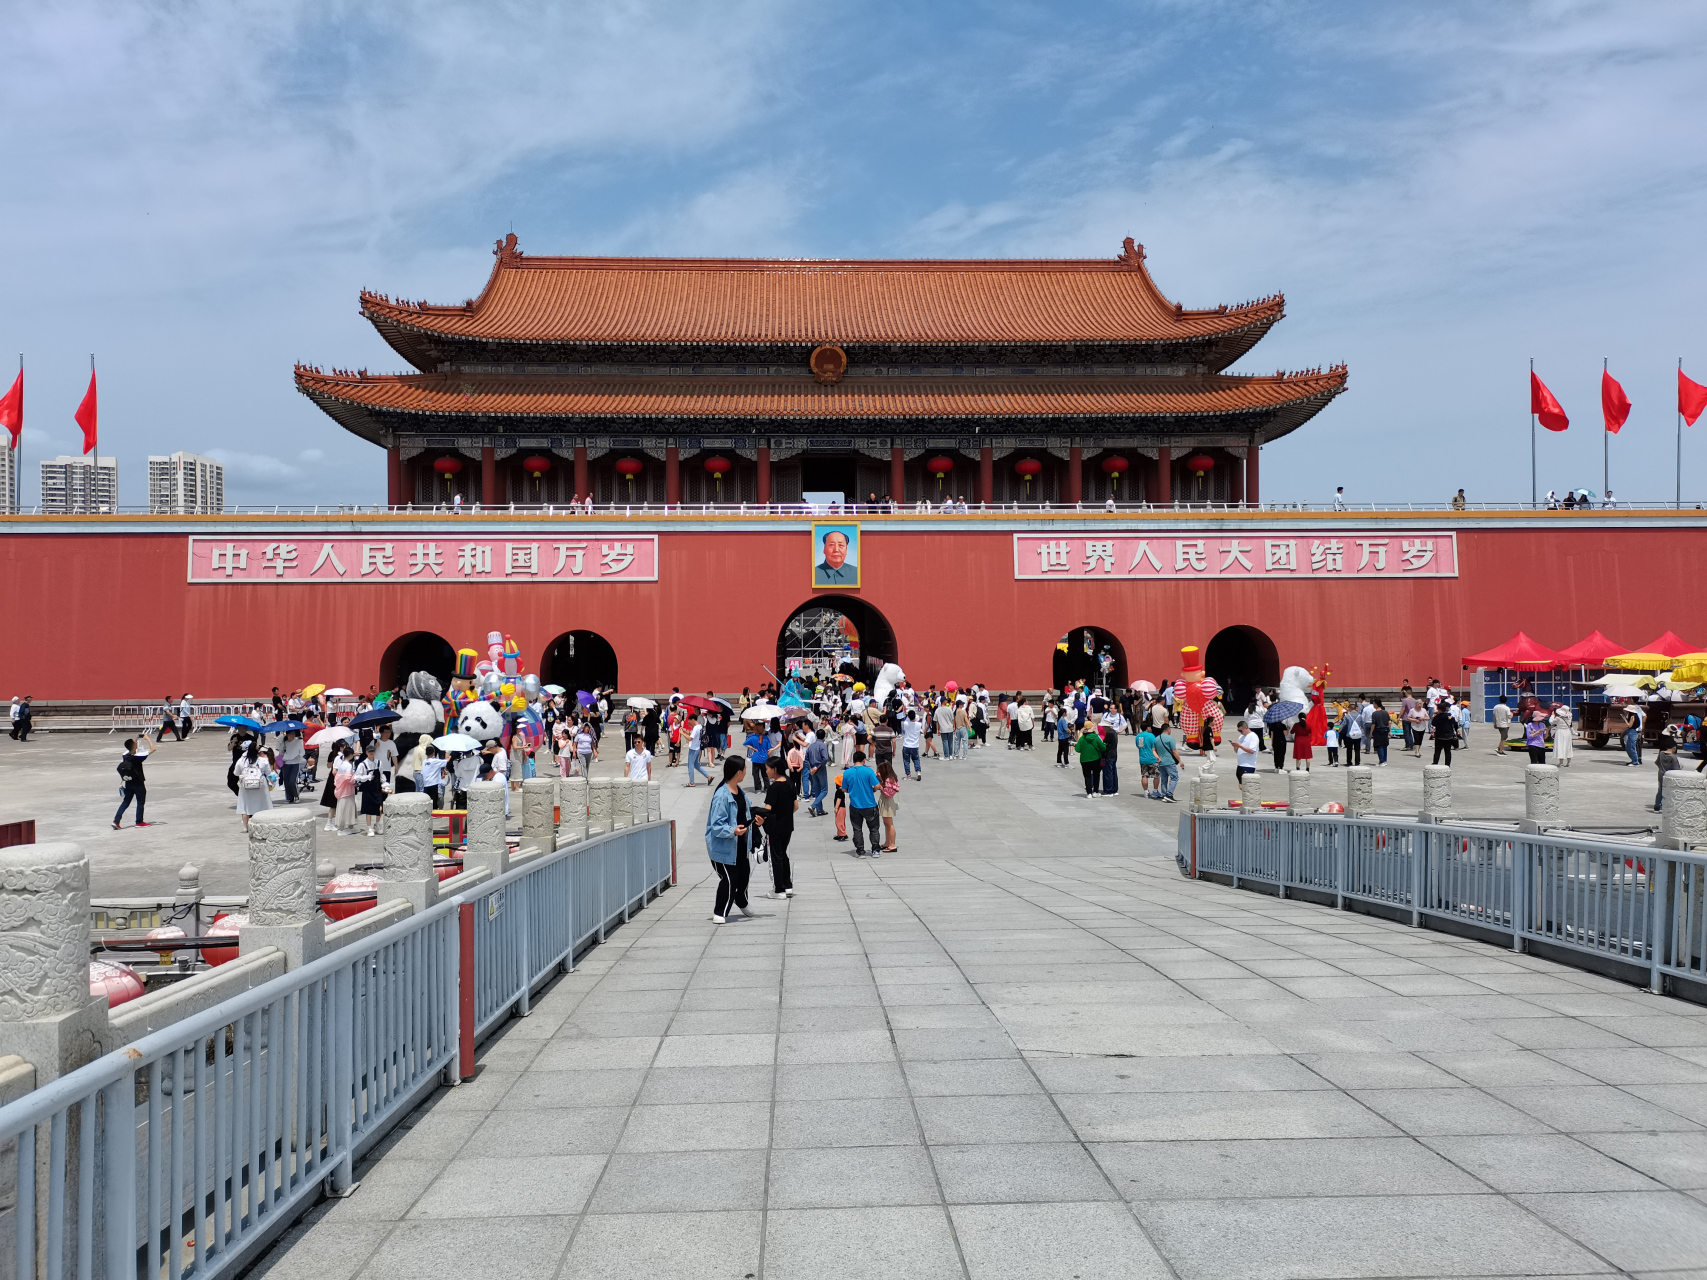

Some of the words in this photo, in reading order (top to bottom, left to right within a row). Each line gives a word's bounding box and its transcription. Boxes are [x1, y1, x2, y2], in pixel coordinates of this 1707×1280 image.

[211, 542, 635, 576] 中华人民共和国万岁
[1036, 539, 1435, 572] 世界人民大团结万岁
